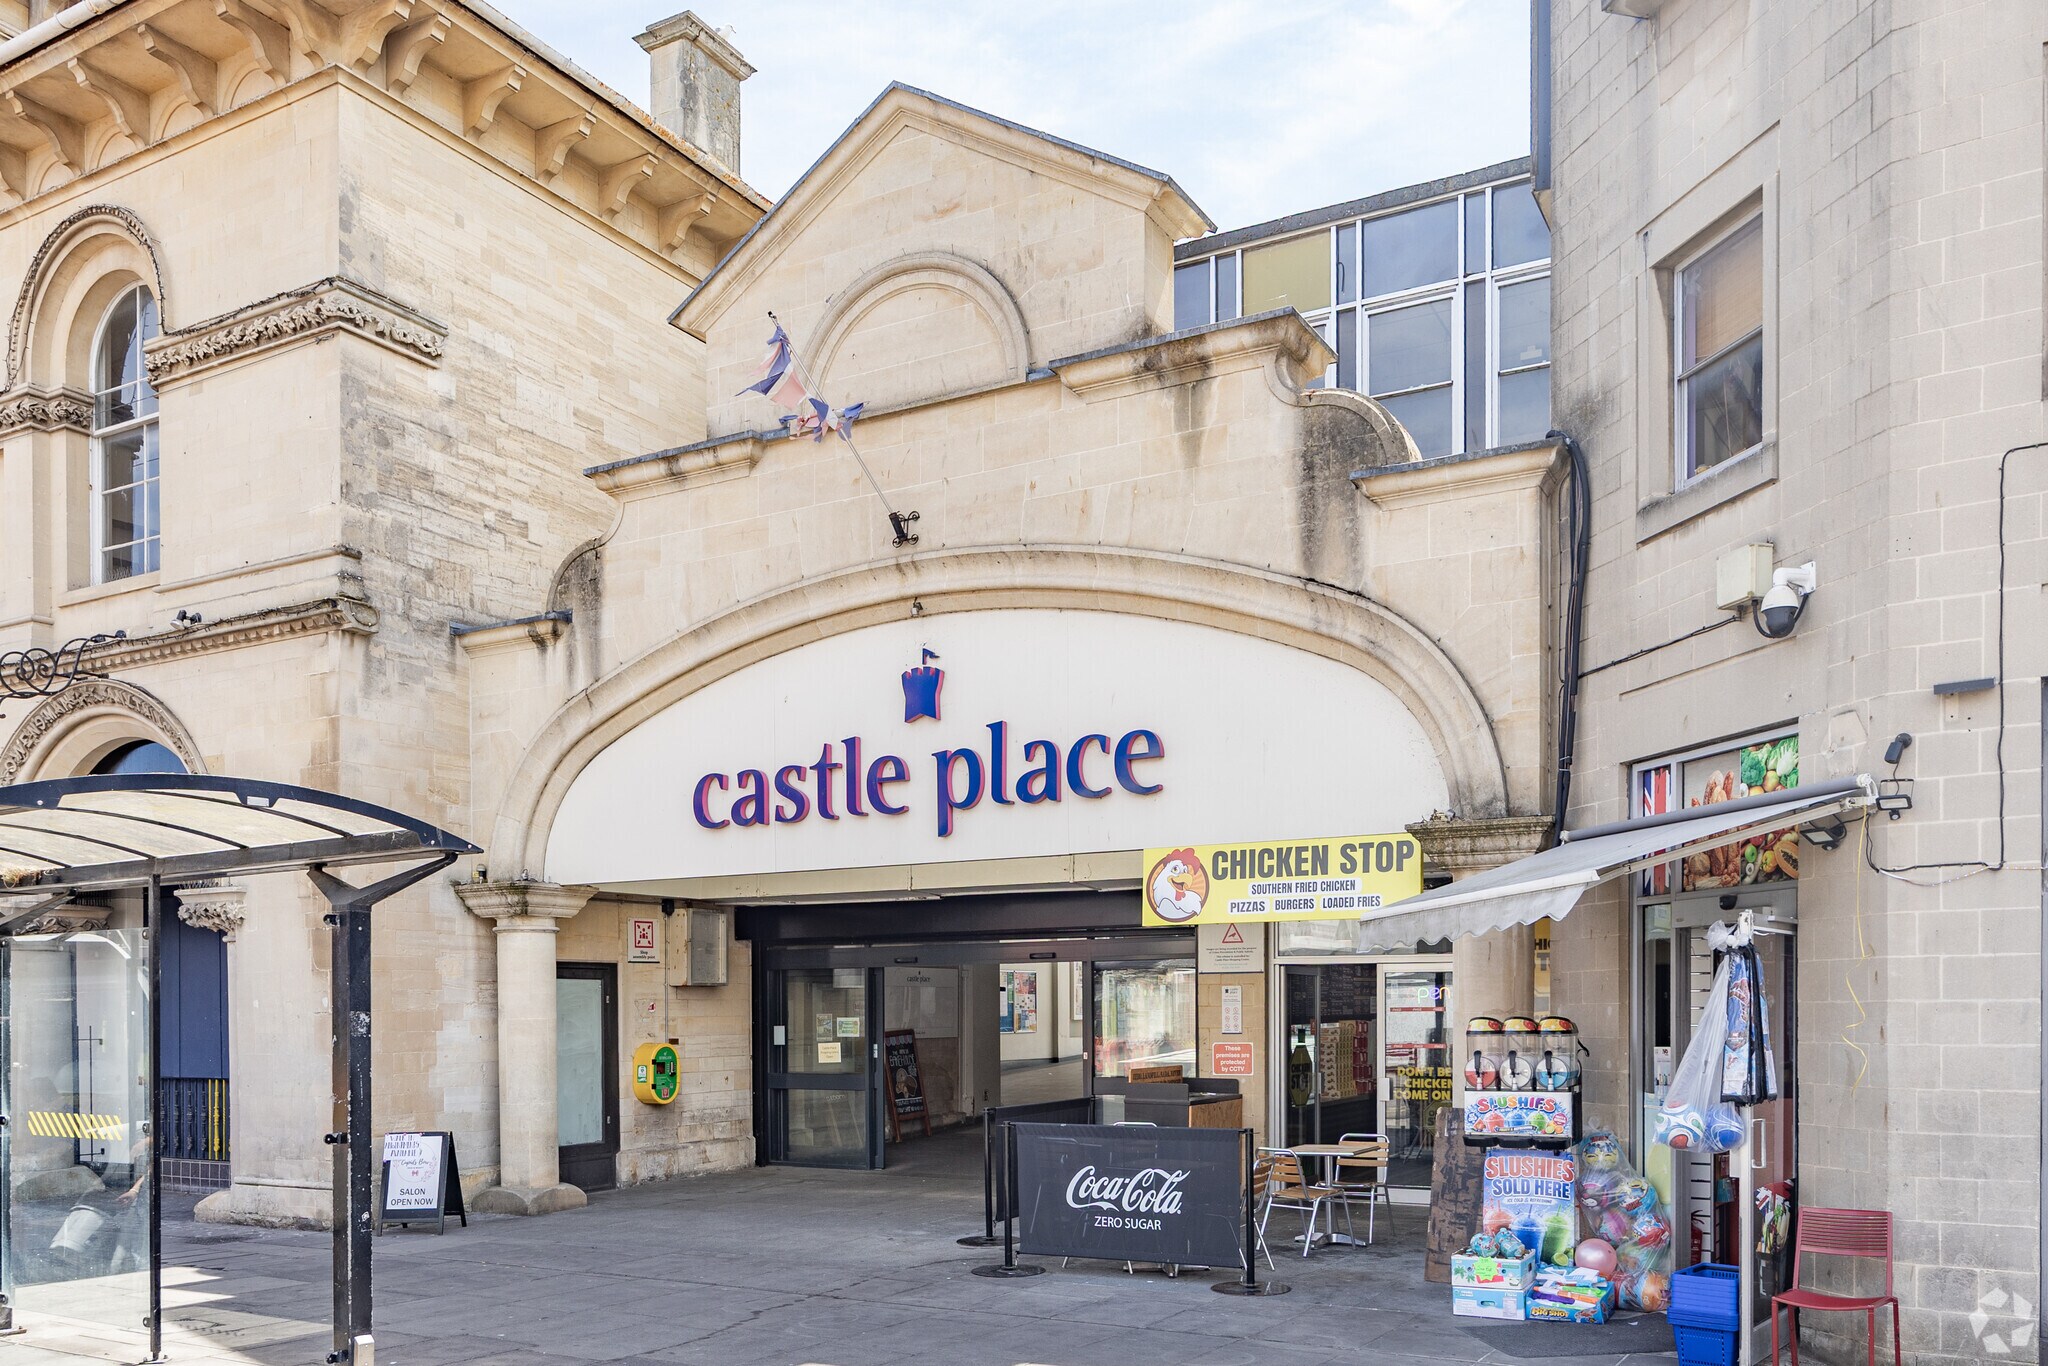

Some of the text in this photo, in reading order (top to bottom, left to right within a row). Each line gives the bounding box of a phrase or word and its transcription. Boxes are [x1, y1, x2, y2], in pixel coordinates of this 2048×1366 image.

[692, 720, 1165, 838] castle place
[1211, 839, 1414, 880] CHICKEN STOP
[1251, 879, 1356, 895] SOUTHERN FRIED CHICKEN
[1230, 895, 1381, 913] PIZZAS BURGERS LOADED FRIES
[1397, 1067, 1452, 1077] DON'T BE
[1395, 1090, 1451, 1100] COME ON
[1485, 1156, 1574, 1182] SLUSHIES
[1065, 1165, 1191, 1215] Coca-Cola
[1492, 1178, 1571, 1199] SOLD HERE
[390, 1198, 412, 1206] OPEN
[1094, 1215, 1162, 1231] ZERO SUGAR
